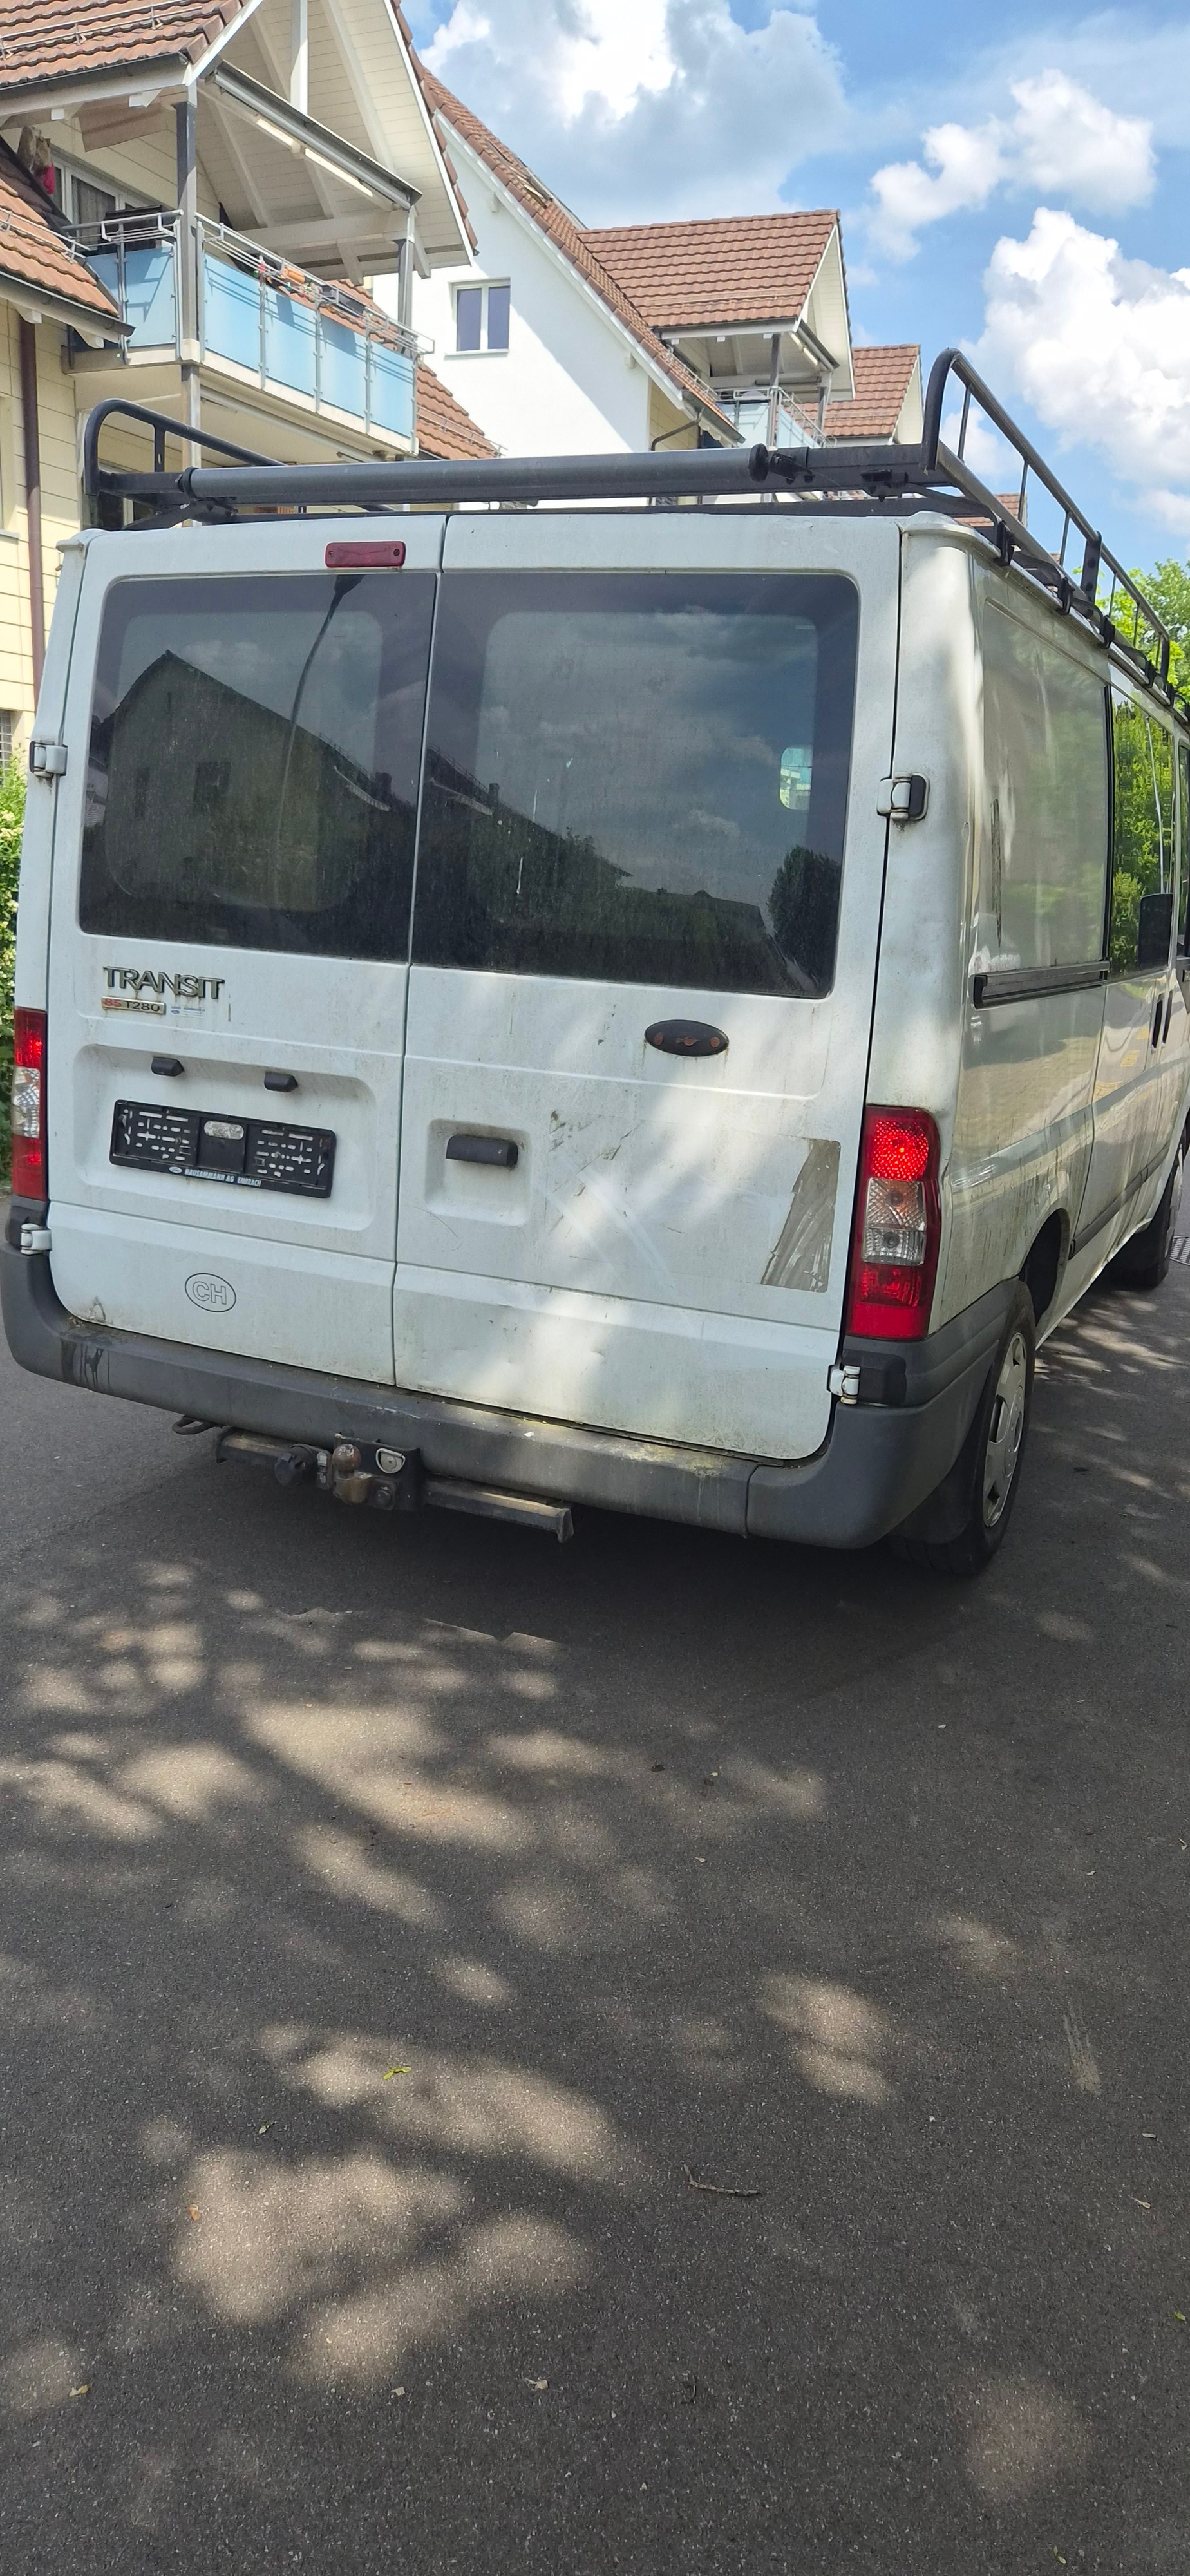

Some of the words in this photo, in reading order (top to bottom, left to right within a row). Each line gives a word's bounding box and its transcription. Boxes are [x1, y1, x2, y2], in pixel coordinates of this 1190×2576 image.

[103, 966, 225, 999] TRANSIT
[103, 999, 122, 1007] 85
[124, 1000, 160, 1012] T280
[237, 1177, 261, 1187] EMBRACH
[192, 1281, 227, 1305] CH
